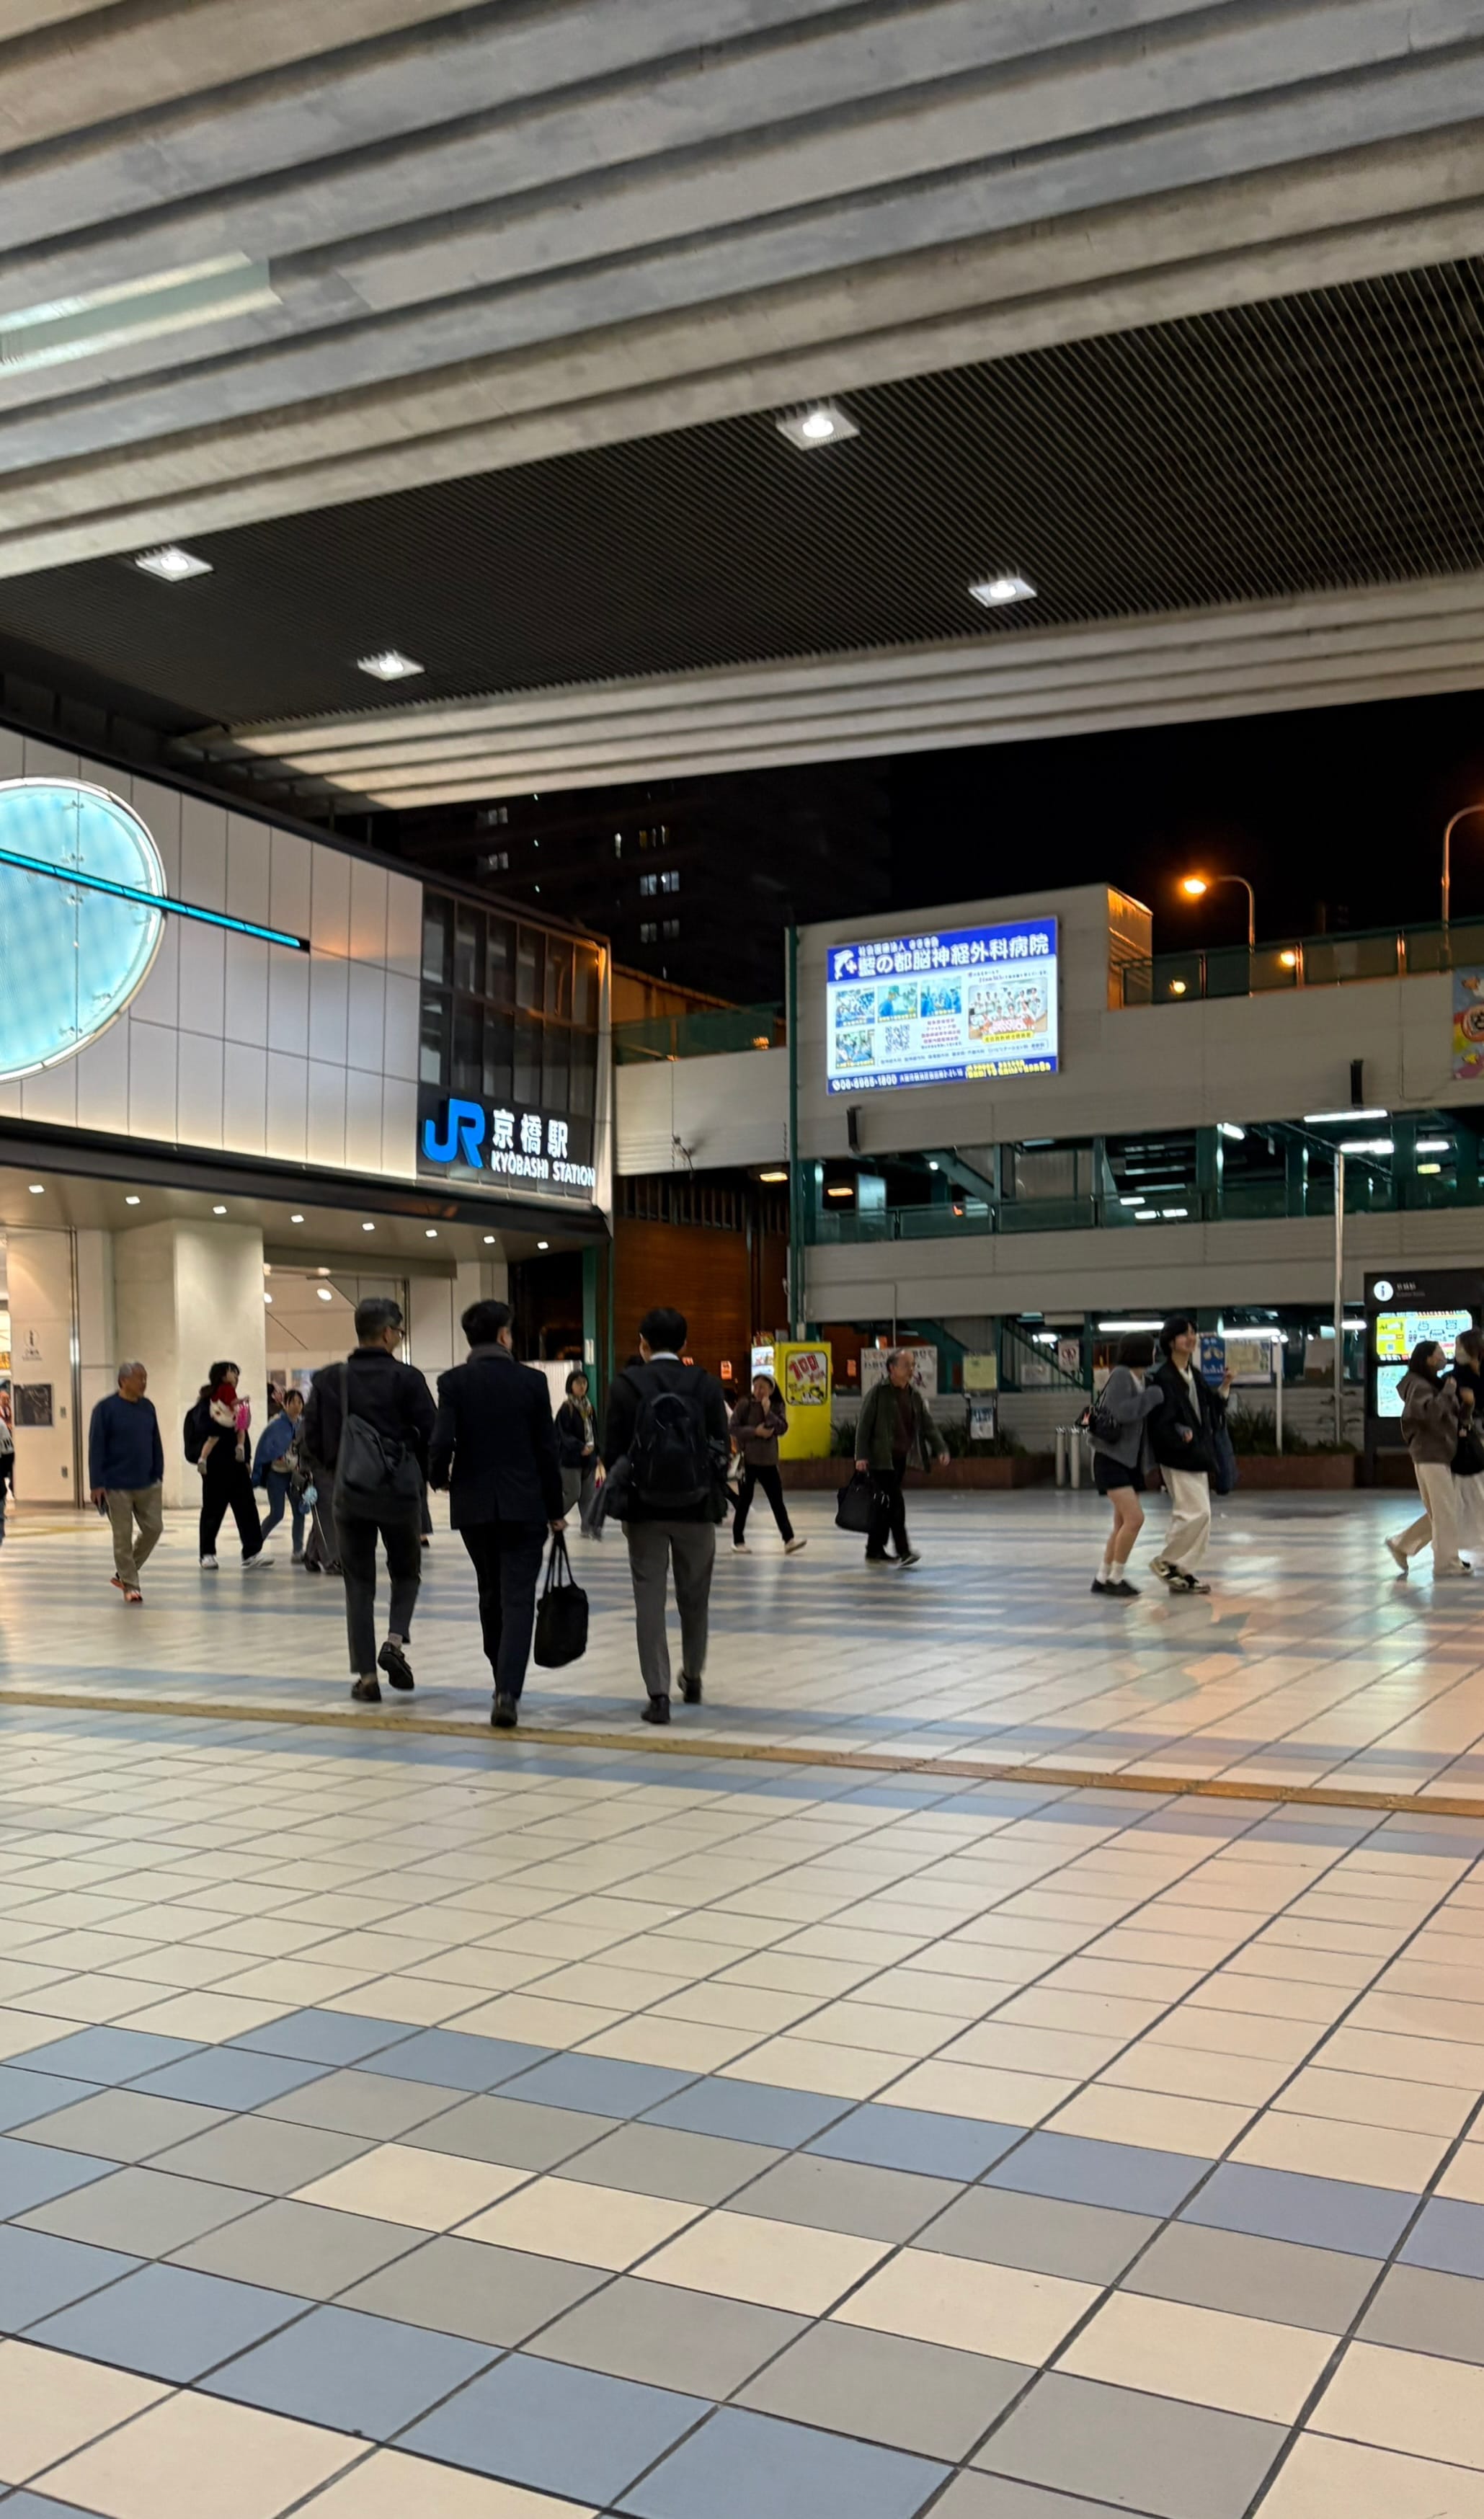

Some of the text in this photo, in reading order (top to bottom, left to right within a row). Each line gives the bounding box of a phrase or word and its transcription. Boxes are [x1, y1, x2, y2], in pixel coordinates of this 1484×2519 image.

[422, 1098, 485, 1168] JR
[492, 1109, 568, 1159] 京橋駅
[553, 1161, 595, 1188] STATION
